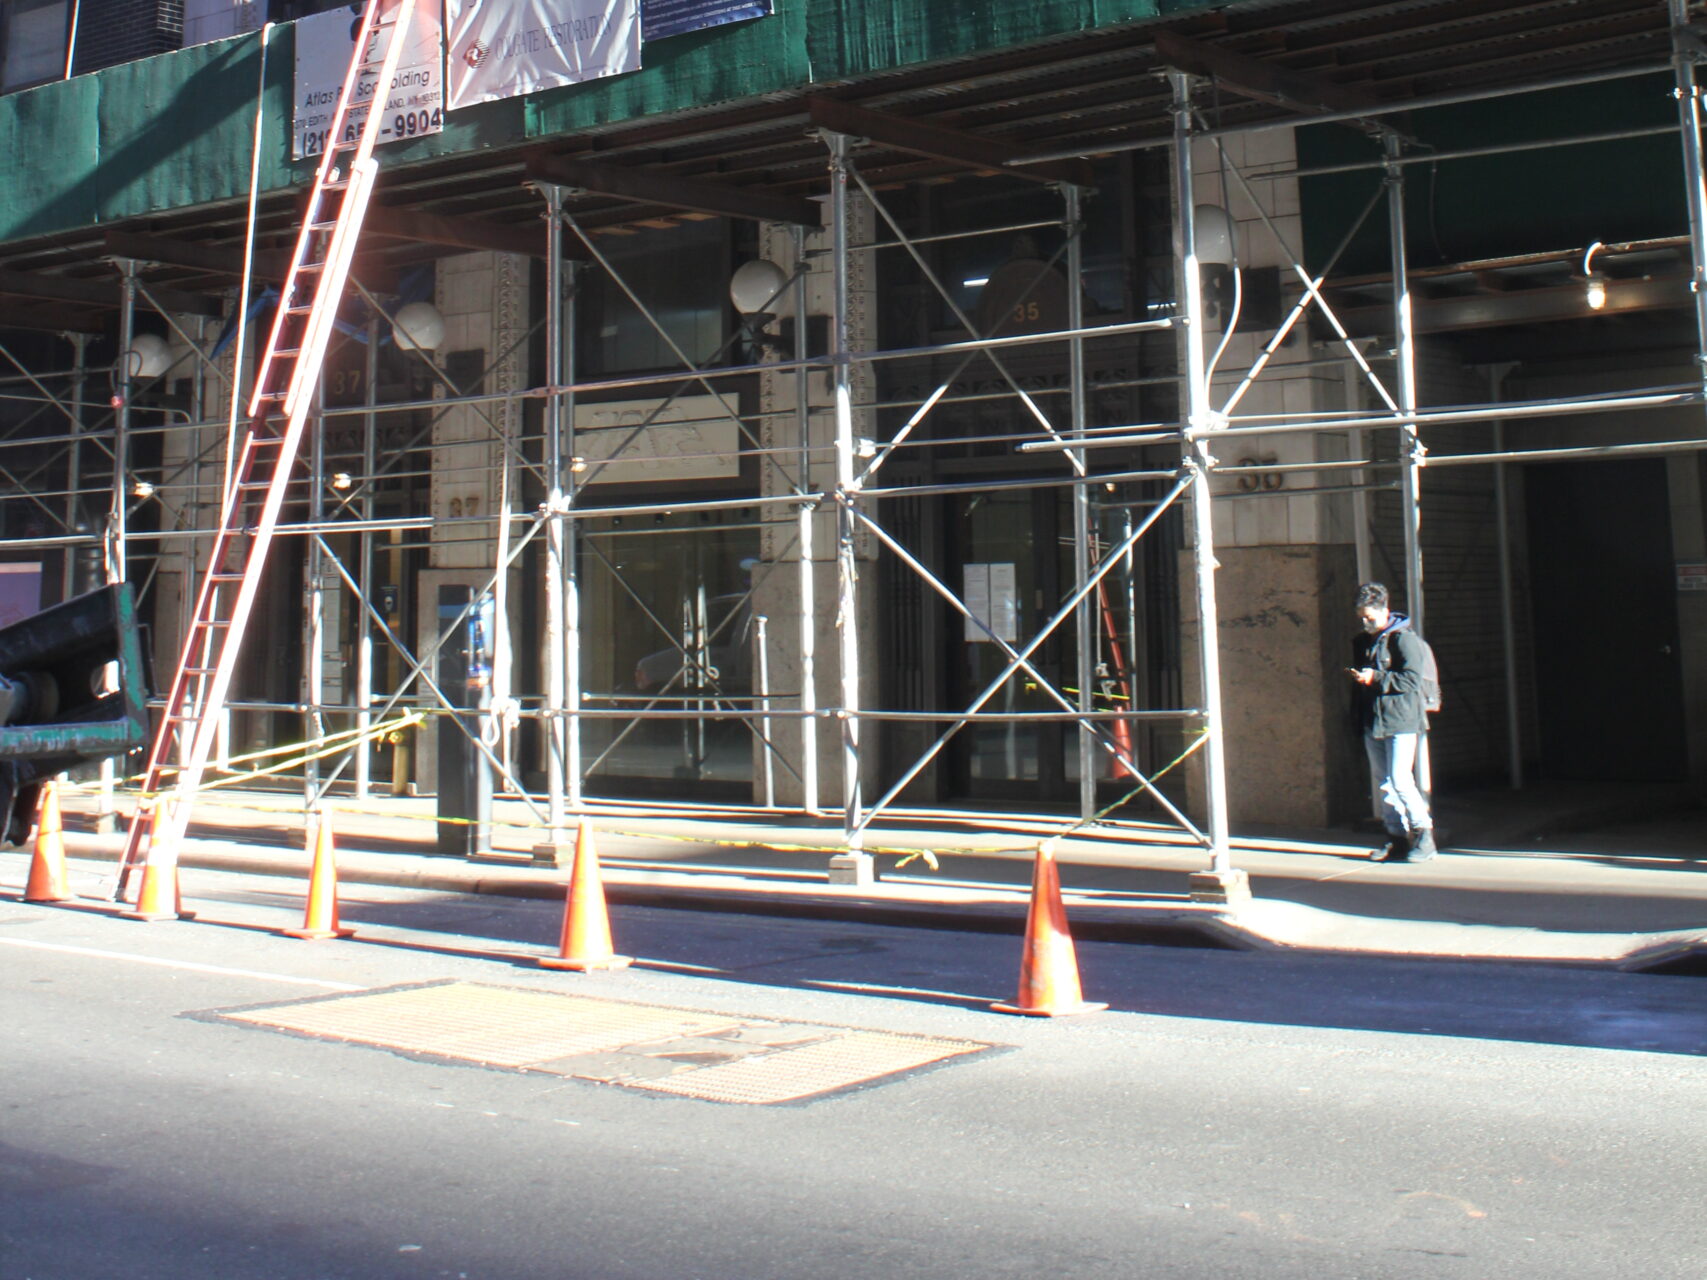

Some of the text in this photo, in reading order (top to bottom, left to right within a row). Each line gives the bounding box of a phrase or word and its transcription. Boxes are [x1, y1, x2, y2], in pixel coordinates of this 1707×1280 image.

[305, 91, 334, 108] Atlas
[357, 70, 430, 97] Scaolding
[1012, 300, 1041, 323] 35
[333, 368, 361, 396] 37
[448, 496, 480, 519] 37
